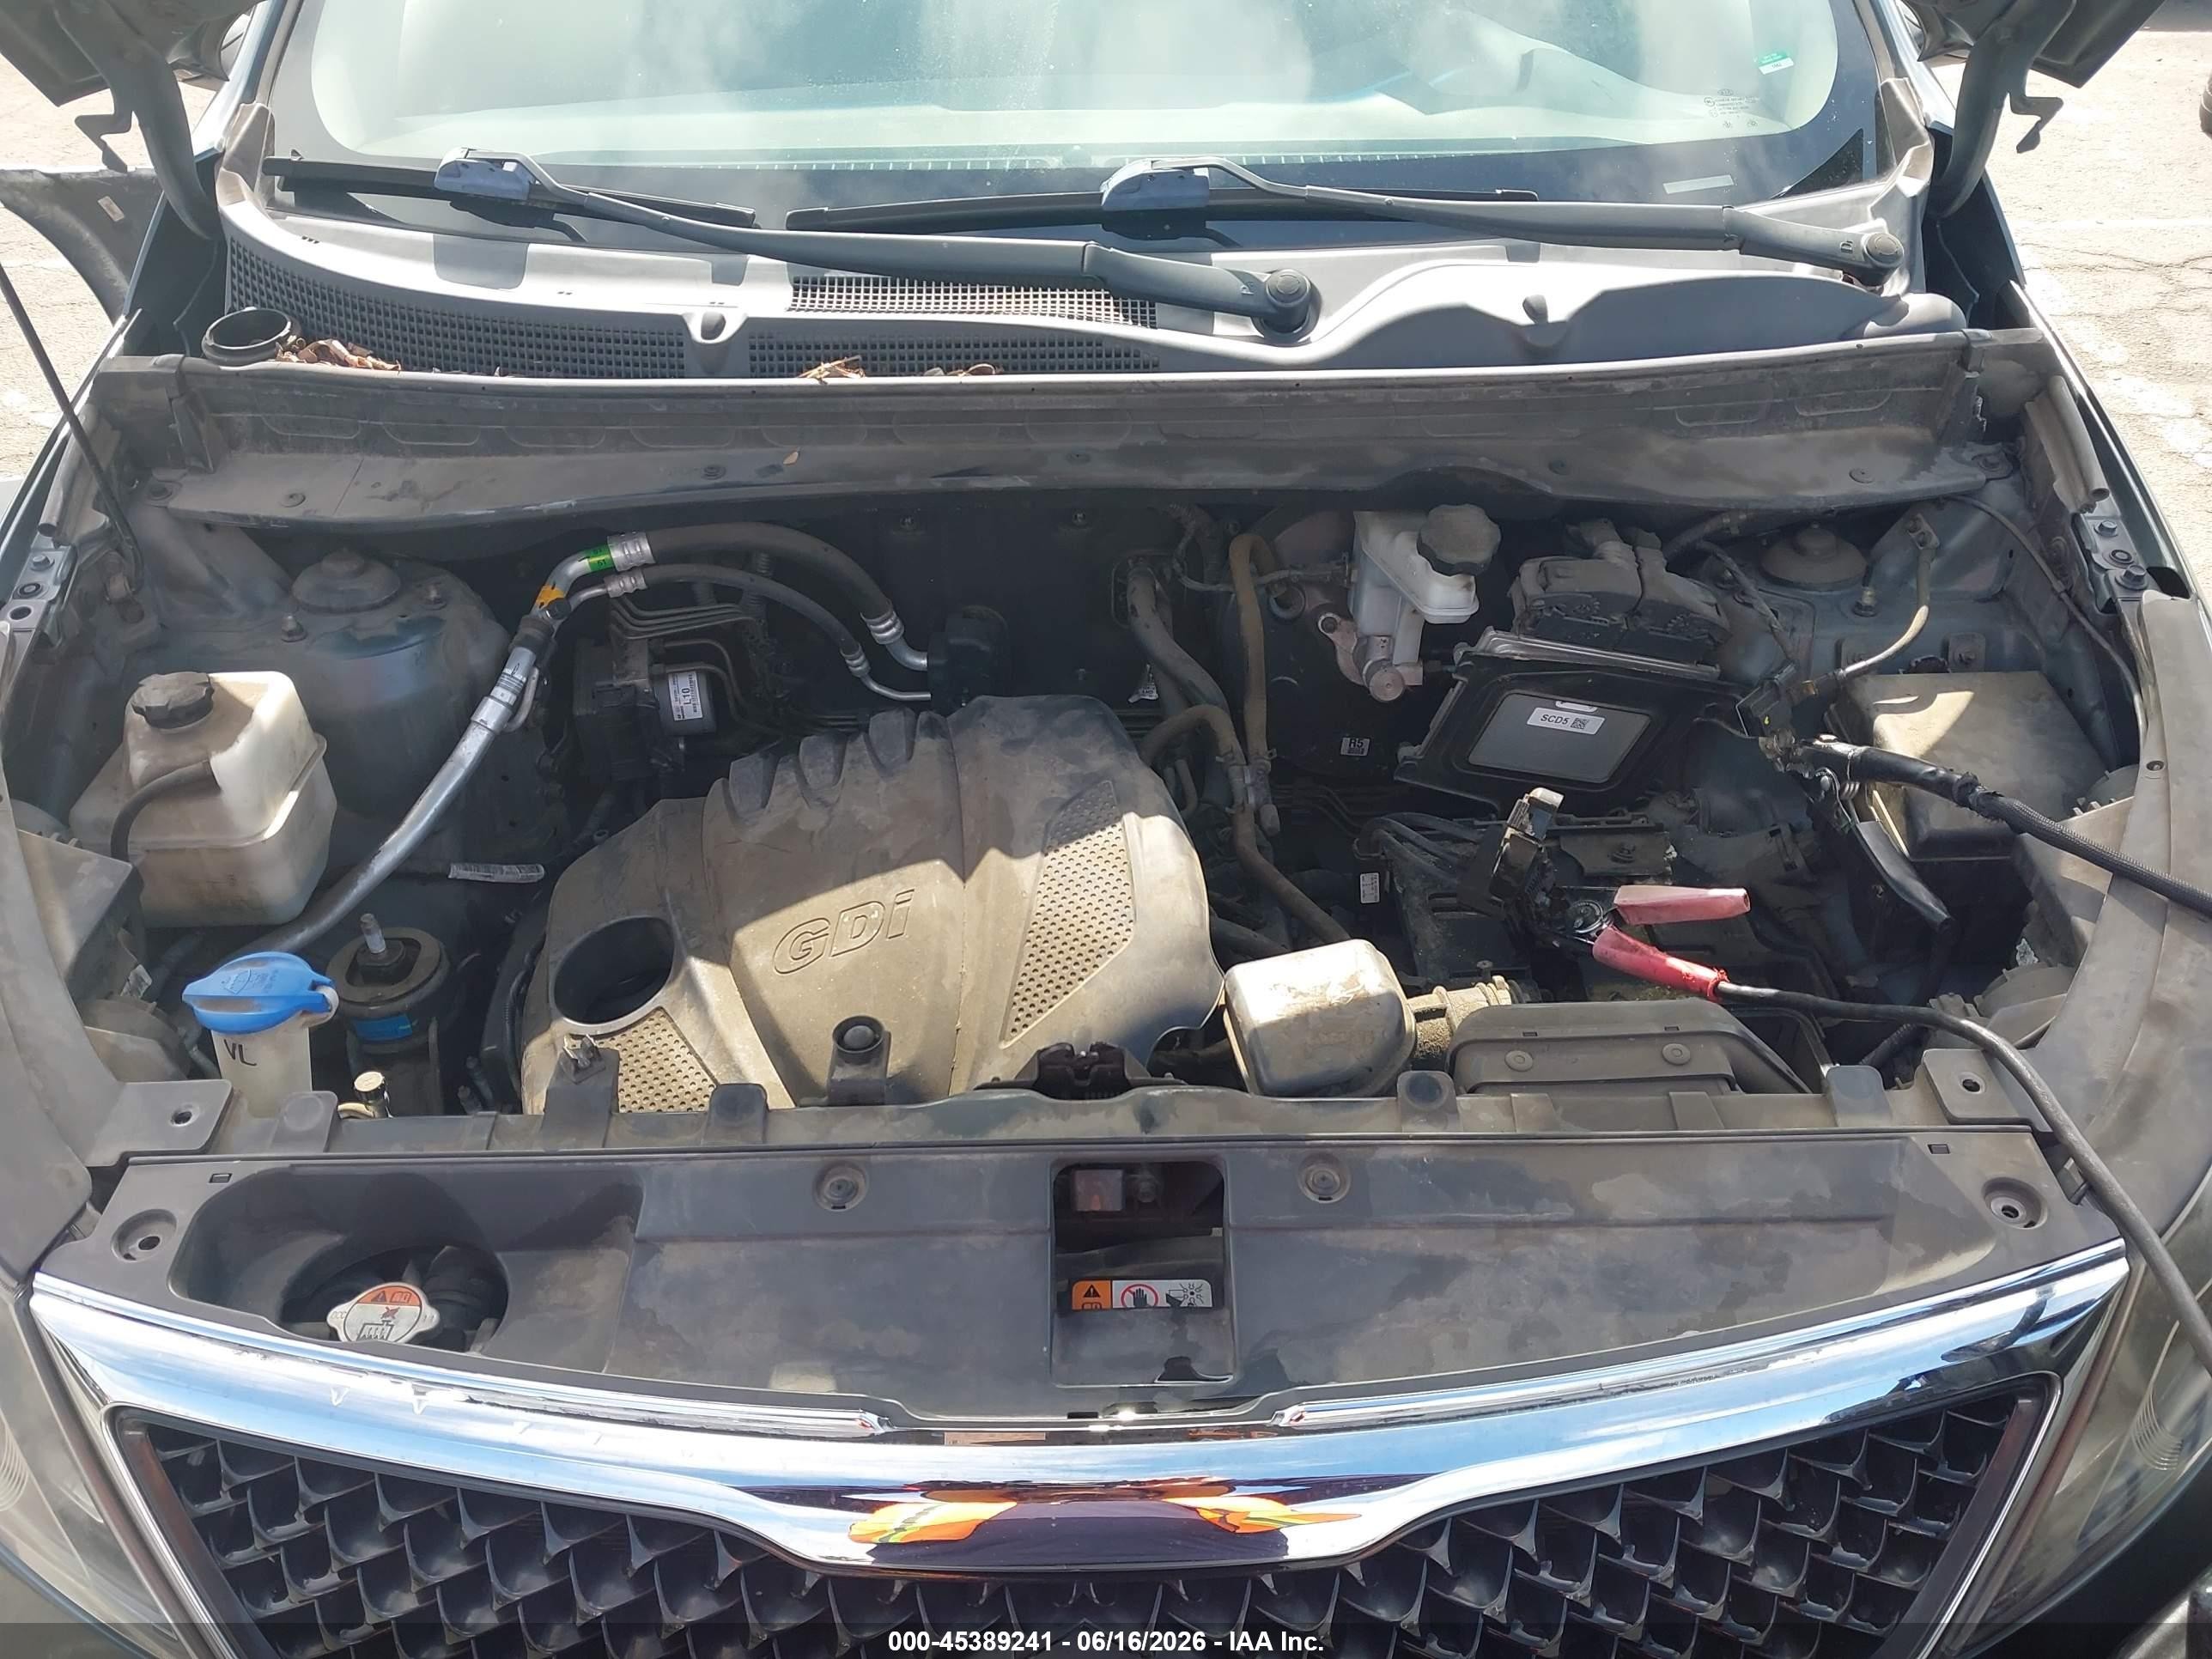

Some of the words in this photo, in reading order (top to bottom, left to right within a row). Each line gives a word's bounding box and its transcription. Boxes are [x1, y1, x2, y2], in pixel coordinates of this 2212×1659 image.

[681, 687, 692, 706] L10
[1540, 714, 1570, 725] SCD5
[773, 888, 915, 975] GDi
